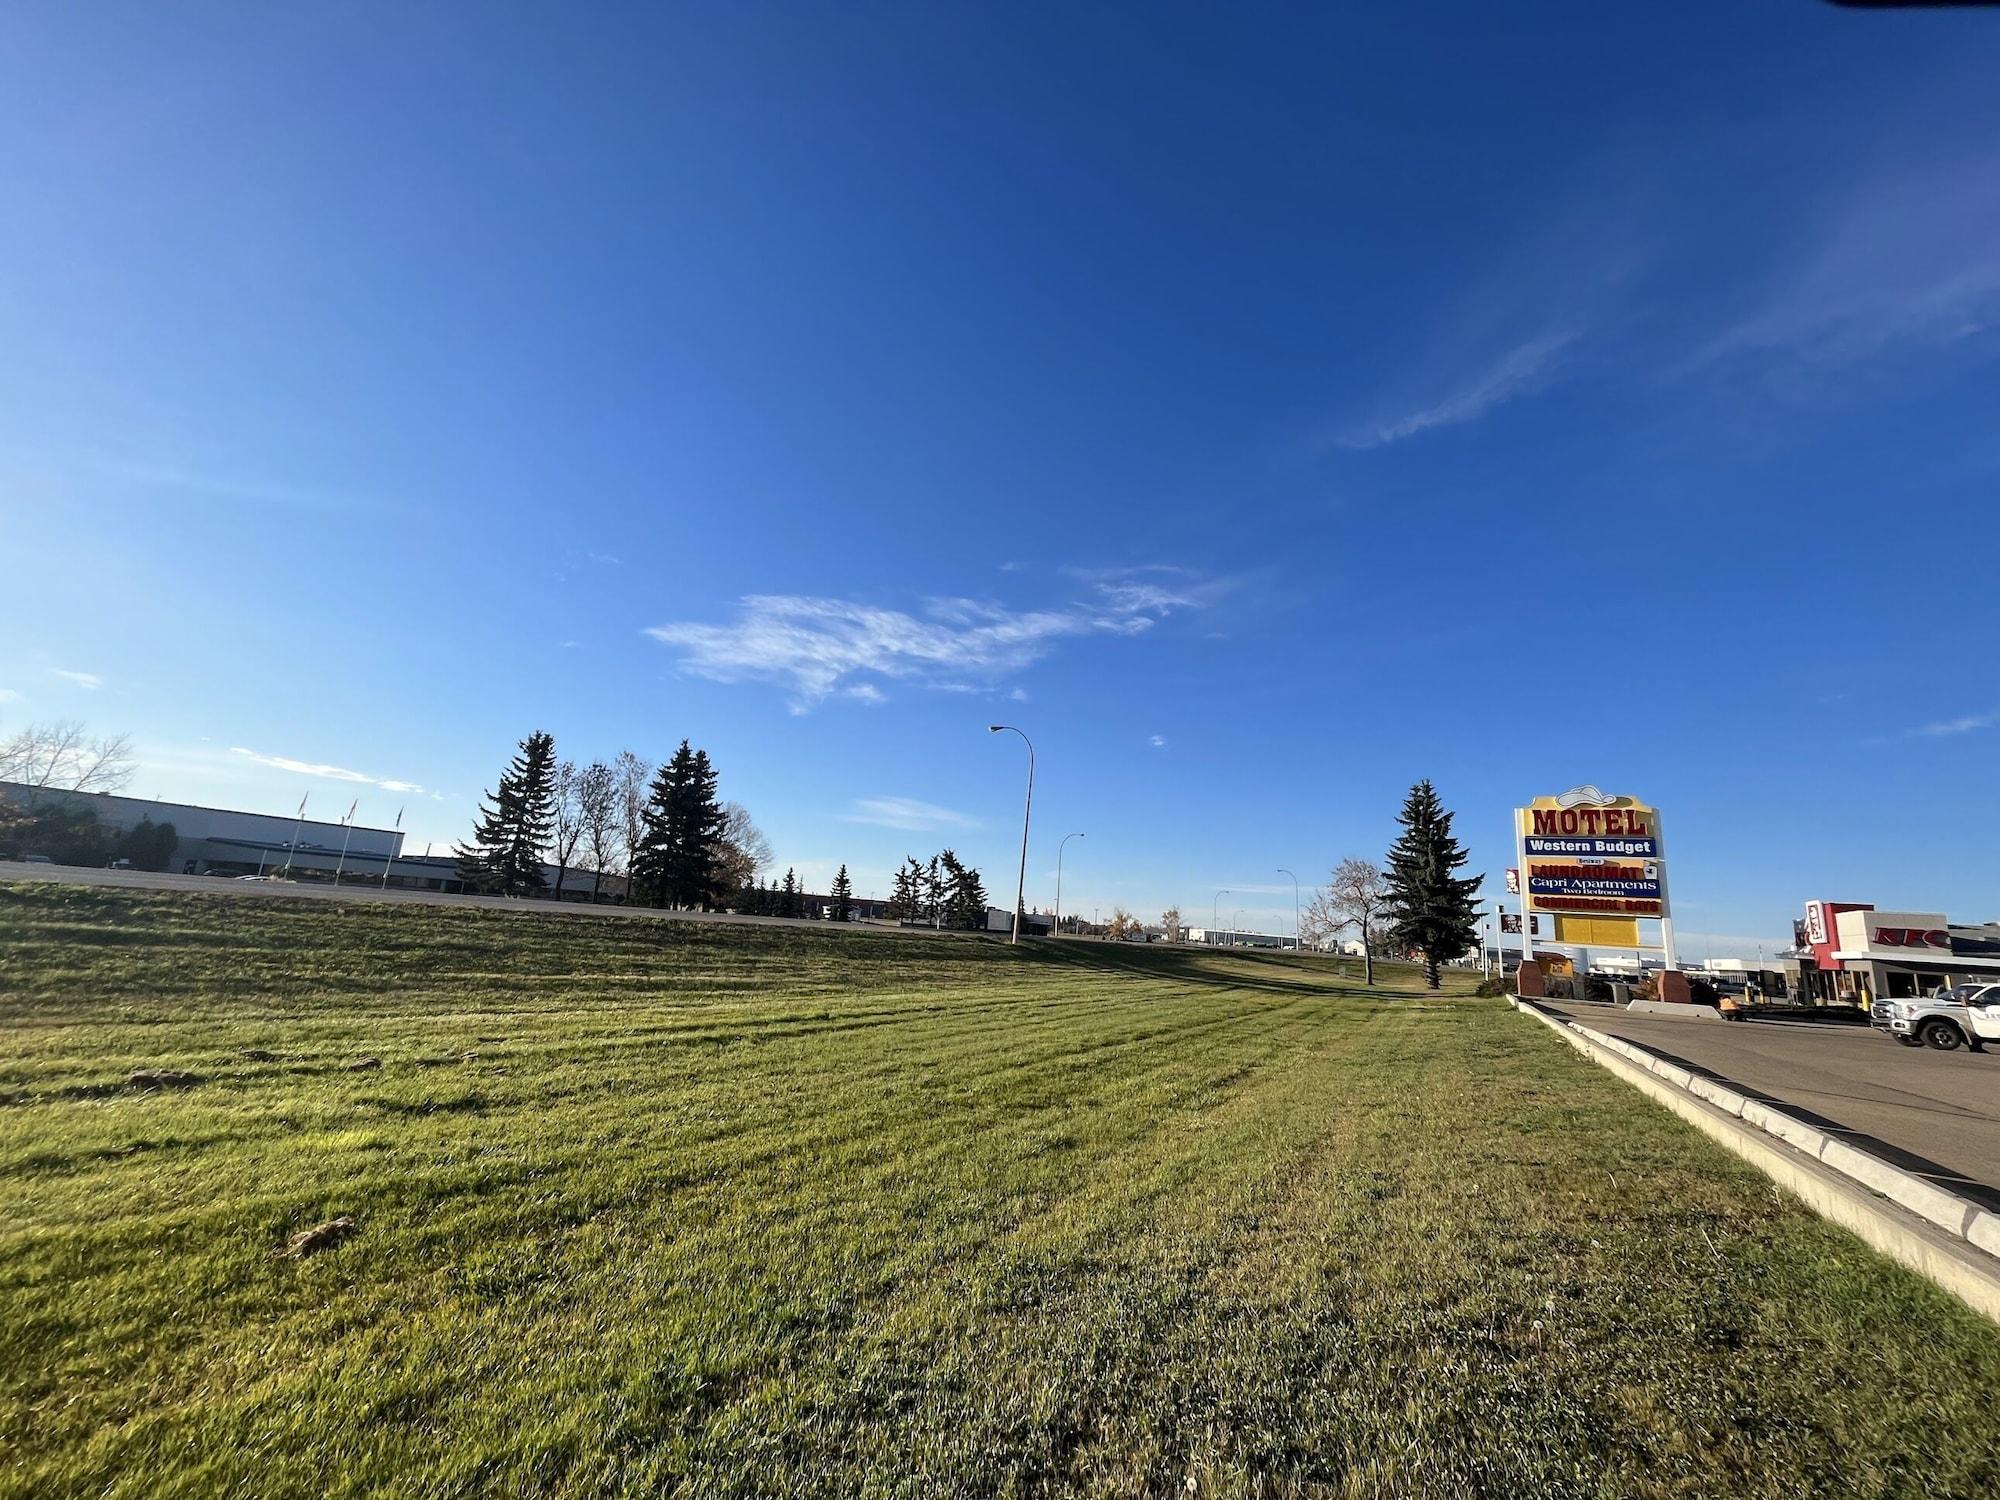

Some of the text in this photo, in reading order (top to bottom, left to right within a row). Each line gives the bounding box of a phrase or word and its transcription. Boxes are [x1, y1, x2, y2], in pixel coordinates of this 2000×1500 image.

[1532, 809, 1647, 835] MOTEL
[1530, 840, 1651, 854] Western Budget
[1531, 877, 1657, 890] Capri Apartments
[1583, 888, 1625, 896] Bedroom
[1534, 896, 1621, 911] COMMERCIAL
[1873, 927, 1951, 949] KFC
